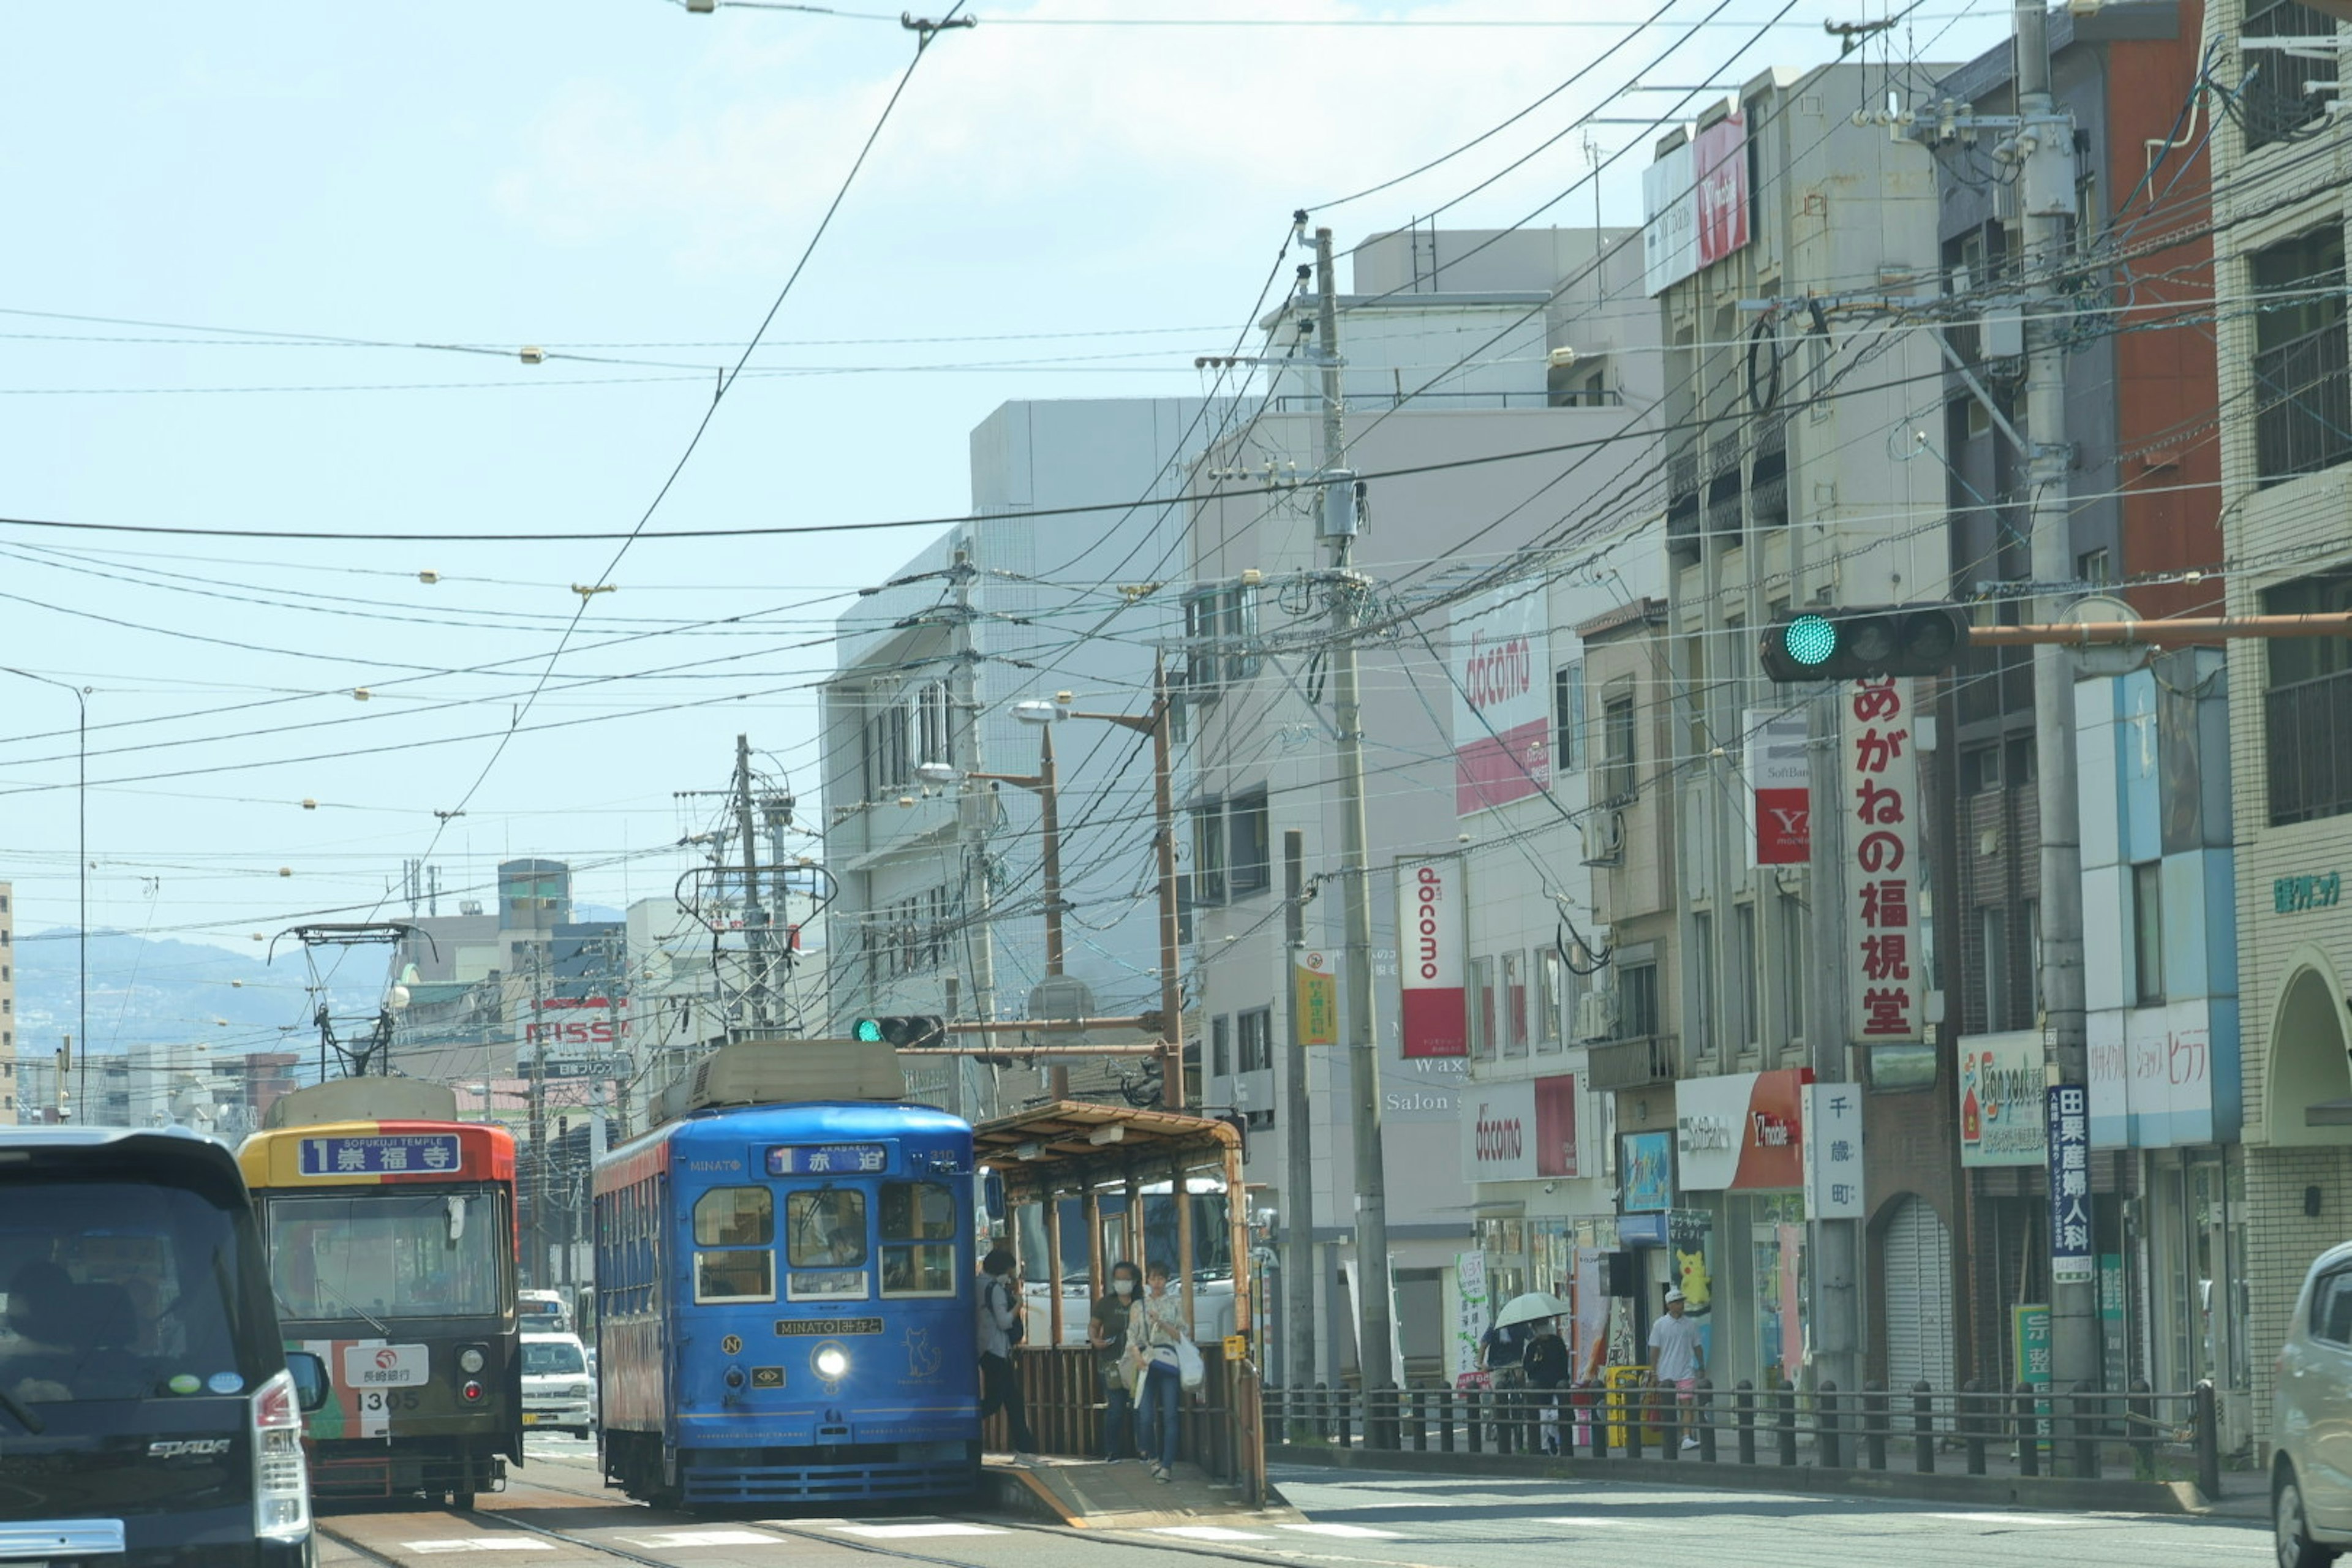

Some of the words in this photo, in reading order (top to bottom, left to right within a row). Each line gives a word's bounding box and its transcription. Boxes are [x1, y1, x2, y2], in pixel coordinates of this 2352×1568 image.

[1466, 633, 1529, 713] docomo
[1767, 767, 1807, 778] SoftBan
[1853, 677, 1912, 1035] めがねの福視堂
[1417, 867, 1441, 979] docomo
[1415, 1058, 1463, 1072] Wax
[1387, 1093, 1448, 1110] Salon
[344, 1138, 398, 1148] SOFUKUJI
[401, 1137, 443, 1147] TEMPLE
[1476, 1103, 1521, 1161] docomo
[313, 1140, 328, 1172] 1
[337, 1146, 450, 1171] 崇福寺
[773, 1147, 793, 1173] 1
[809, 1151, 883, 1172] 赤迫
[1829, 1096, 1850, 1205] 千歳町
[2060, 1089, 2089, 1251] 田栗産婦人科
[782, 1322, 835, 1335] MINATO
[841, 1319, 881, 1333] みなと
[358, 1390, 420, 1412] 1305
[147, 1439, 232, 1458] SPADA
